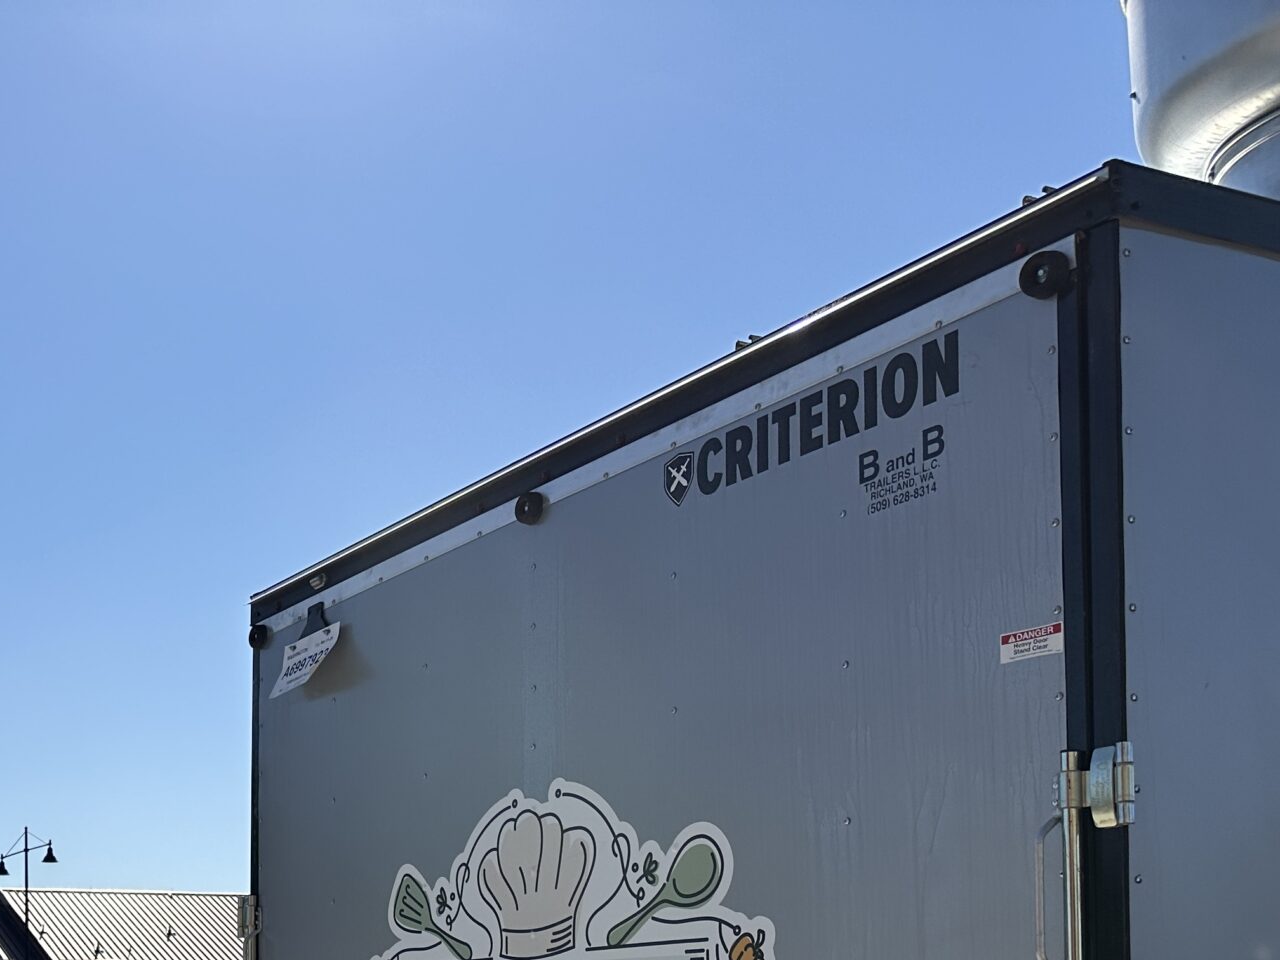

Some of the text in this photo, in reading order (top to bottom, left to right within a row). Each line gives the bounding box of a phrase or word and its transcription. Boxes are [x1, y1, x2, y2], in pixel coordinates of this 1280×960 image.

[697, 330, 960, 496] CRITERION
[858, 424, 945, 485] B and B
[864, 468, 911, 493] TRAILERS
[920, 471, 935, 484] WA
[867, 481, 937, 516] (509) 628-8314
[1016, 626, 1054, 641] DANGER
[1013, 647, 1031, 656] Stand
[1032, 643, 1048, 651] Clear
